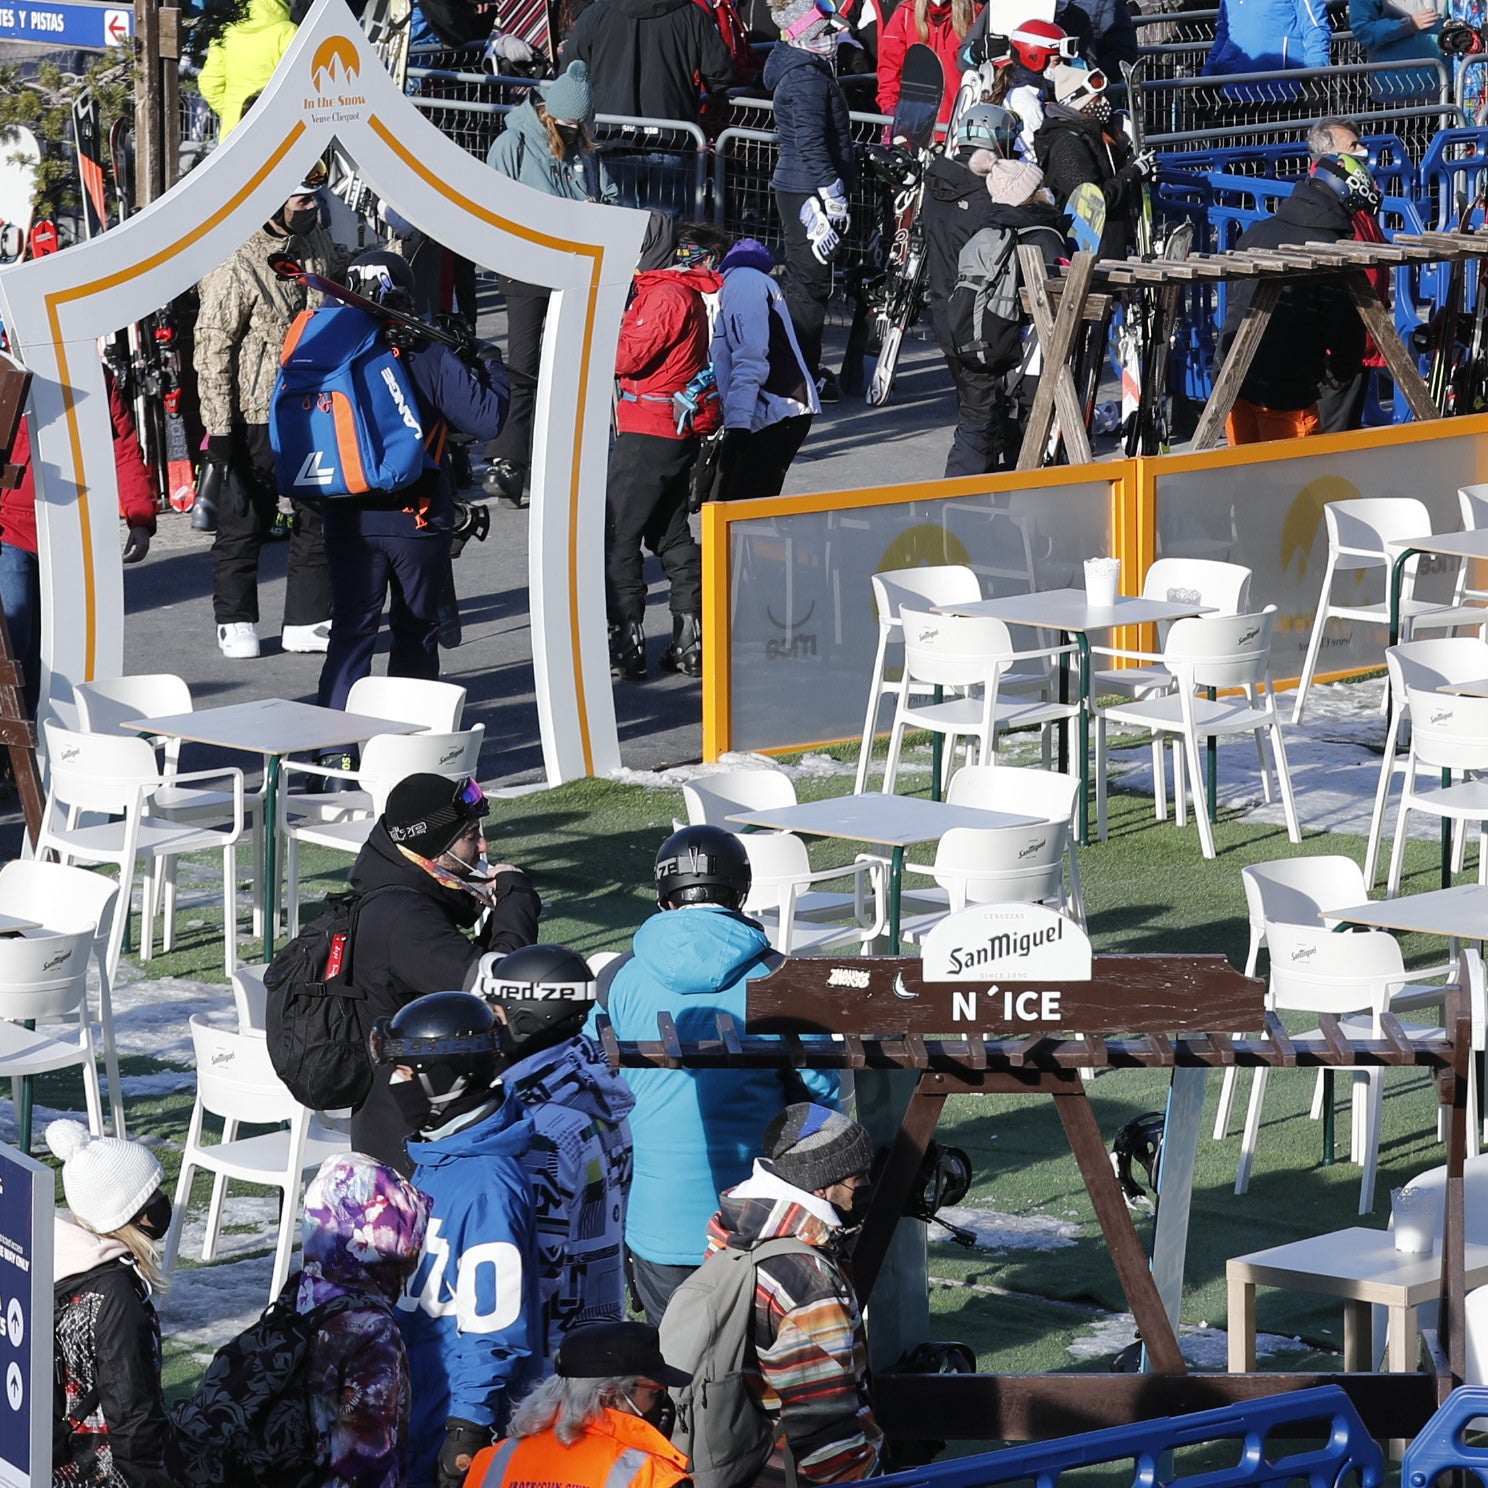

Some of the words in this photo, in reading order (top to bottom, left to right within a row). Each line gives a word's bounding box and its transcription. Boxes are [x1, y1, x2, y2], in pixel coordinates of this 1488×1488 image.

[19, 11, 26, 29] Y
[31, 12, 64, 32] PISTAS
[304, 98, 315, 110] In
[317, 97, 336, 108] the
[338, 95, 367, 107] Snow
[311, 114, 330, 124] Veuve
[332, 112, 360, 124] Clicquot
[380, 366, 424, 440] LANGE
[3, 1245, 15, 1264] WAY
[15, 1250, 30, 1272] ONLY
